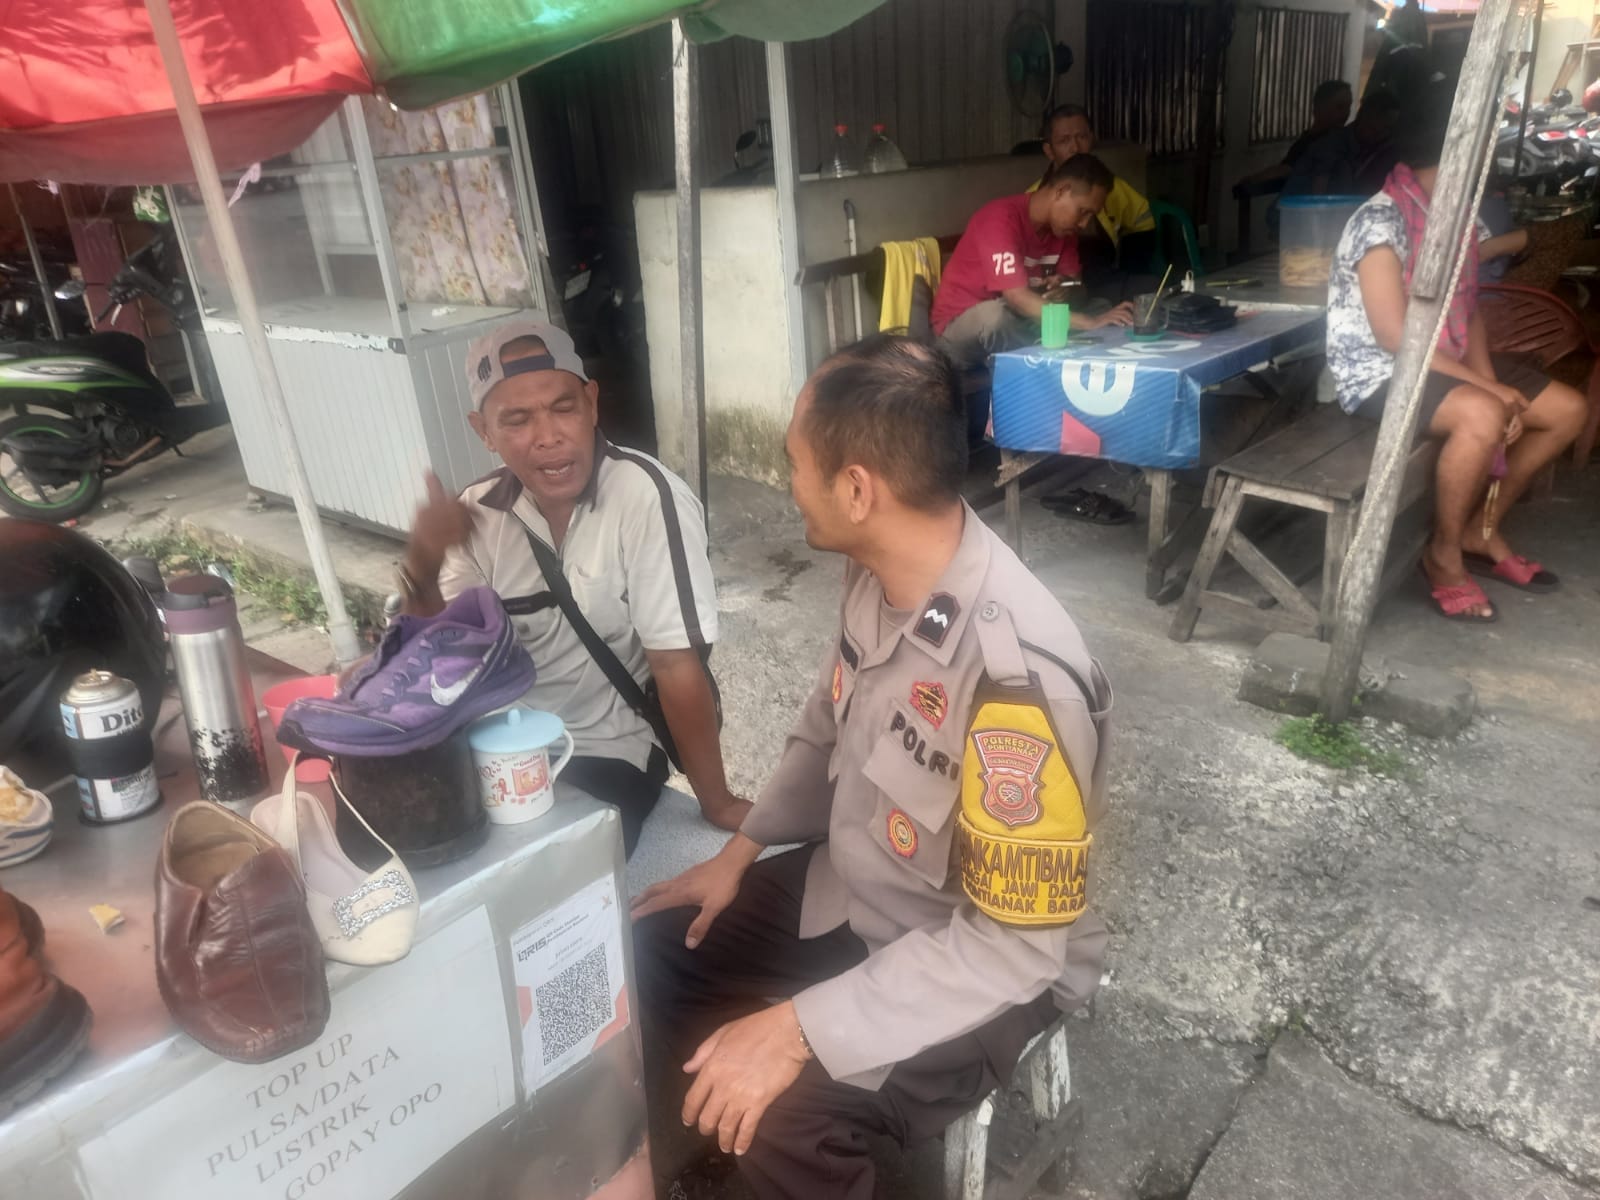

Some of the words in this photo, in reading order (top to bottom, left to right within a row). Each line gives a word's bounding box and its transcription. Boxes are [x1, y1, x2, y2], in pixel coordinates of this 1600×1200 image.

[991, 251, 1016, 276] 72
[890, 710, 960, 781] POLRI
[1001, 880, 1039, 899] JAWI
[246, 1062, 308, 1110] TOP
[316, 1033, 353, 1070] UP
[206, 1046, 401, 1178] PULSA/DATA
[255, 1094, 372, 1185] LISTRIK
[285, 1120, 380, 1200] GOPAY
[389, 1082, 443, 1127] OPO
